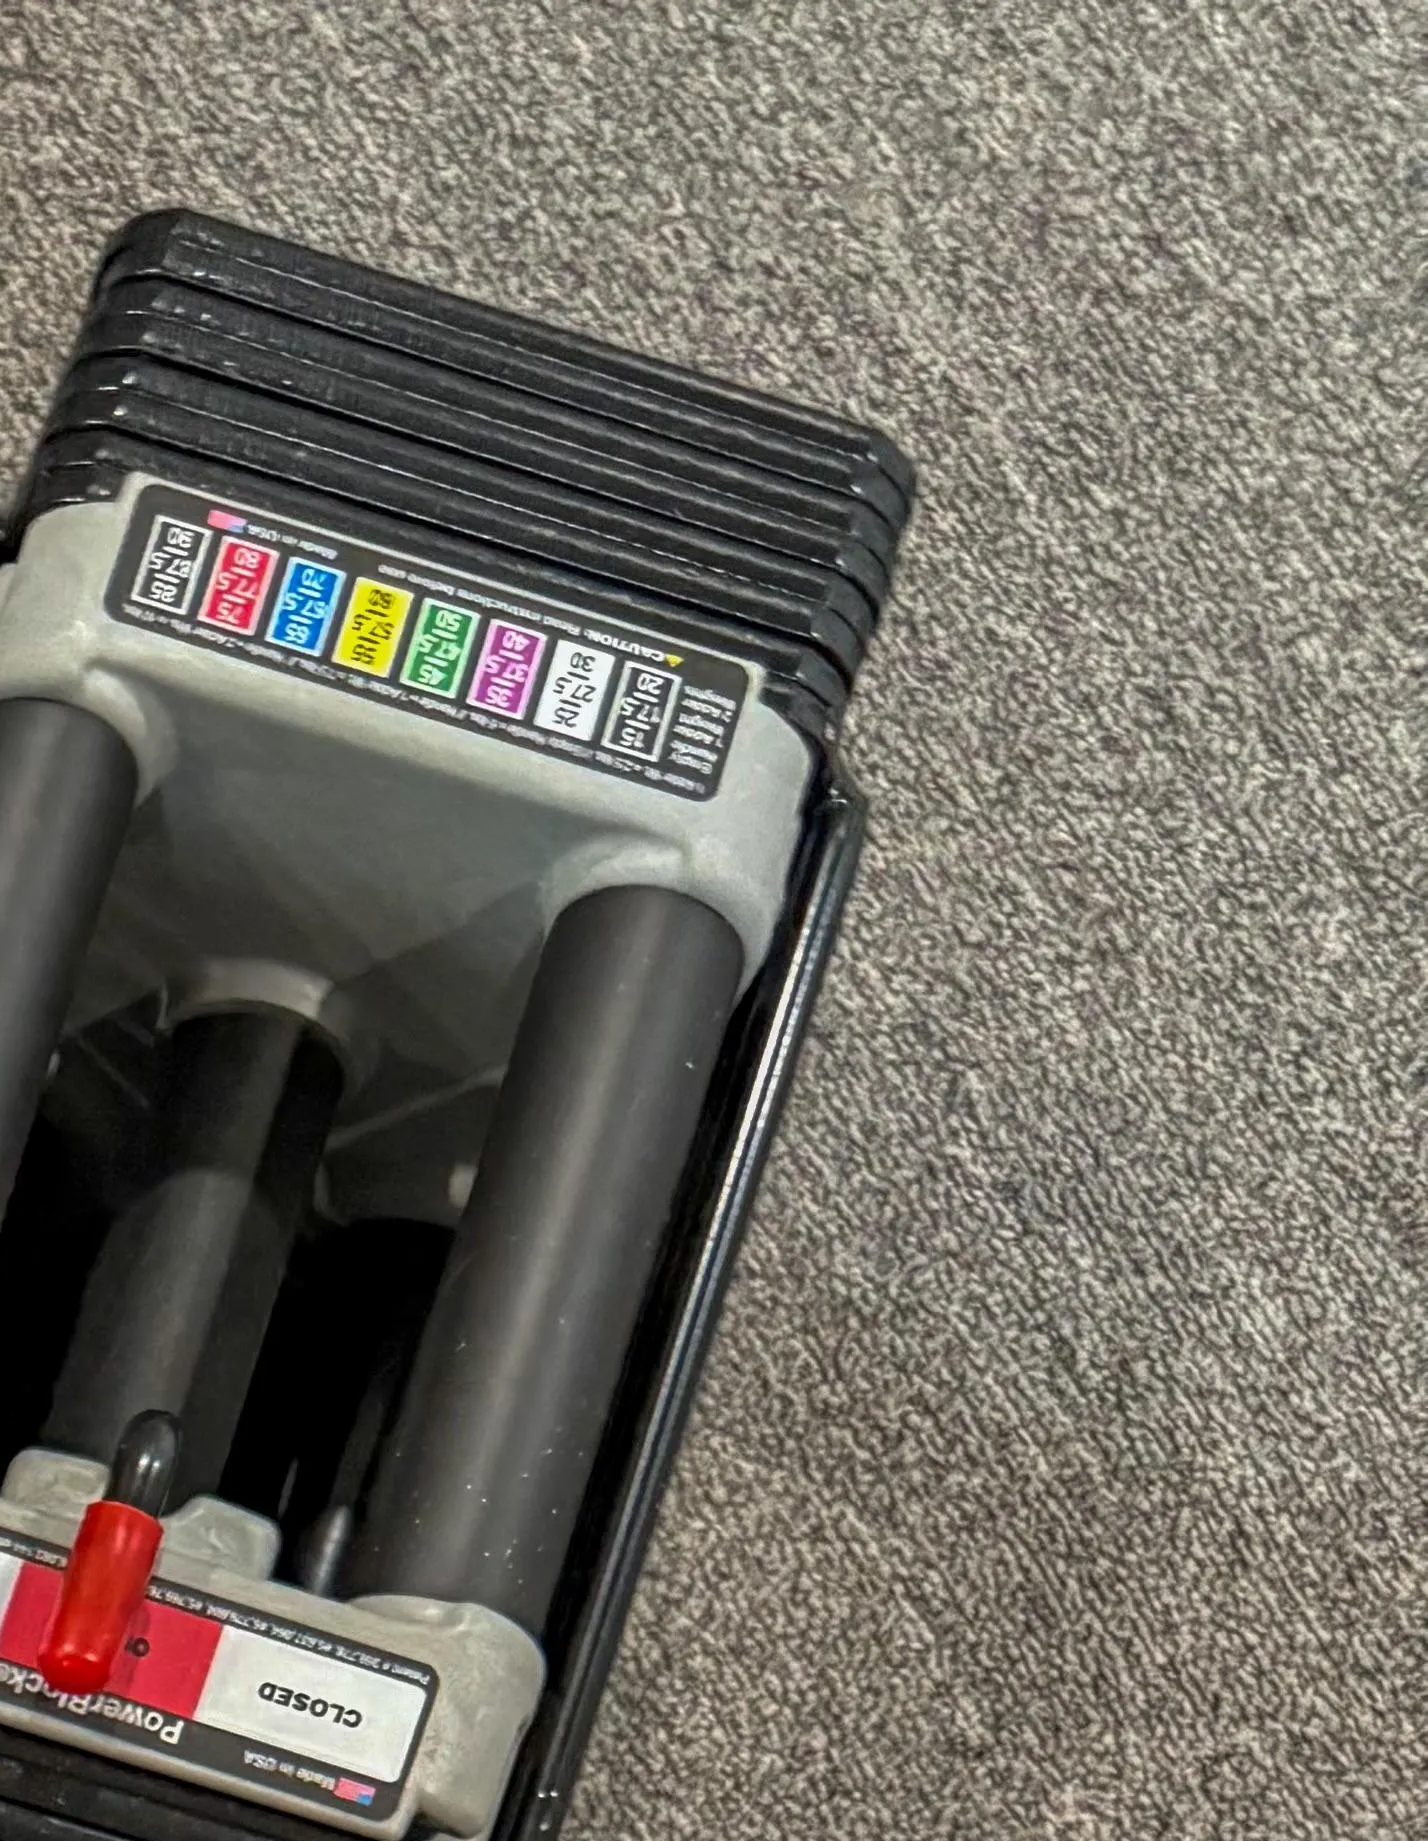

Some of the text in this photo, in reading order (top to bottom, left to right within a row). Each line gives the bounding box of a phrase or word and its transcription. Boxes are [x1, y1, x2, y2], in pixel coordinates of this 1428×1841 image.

[215, 570, 260, 599] 77.5
[299, 566, 328, 590] 70
[214, 600, 243, 624] 75
[433, 607, 463, 632] 50
[350, 612, 395, 641] 57.5
[500, 629, 530, 653] 40
[483, 652, 529, 682] 37.5
[568, 650, 596, 673] 30
[416, 662, 447, 688] 45
[634, 670, 665, 695] 20
[483, 684, 513, 708] 35
[551, 675, 596, 703] 27.5
[551, 705, 579, 728] 25
[617, 695, 664, 725] 17.5
[617, 725, 648, 751] 15
[255, 1680, 363, 1729] CLOSED
[241, 1749, 336, 1790] Made in USA
